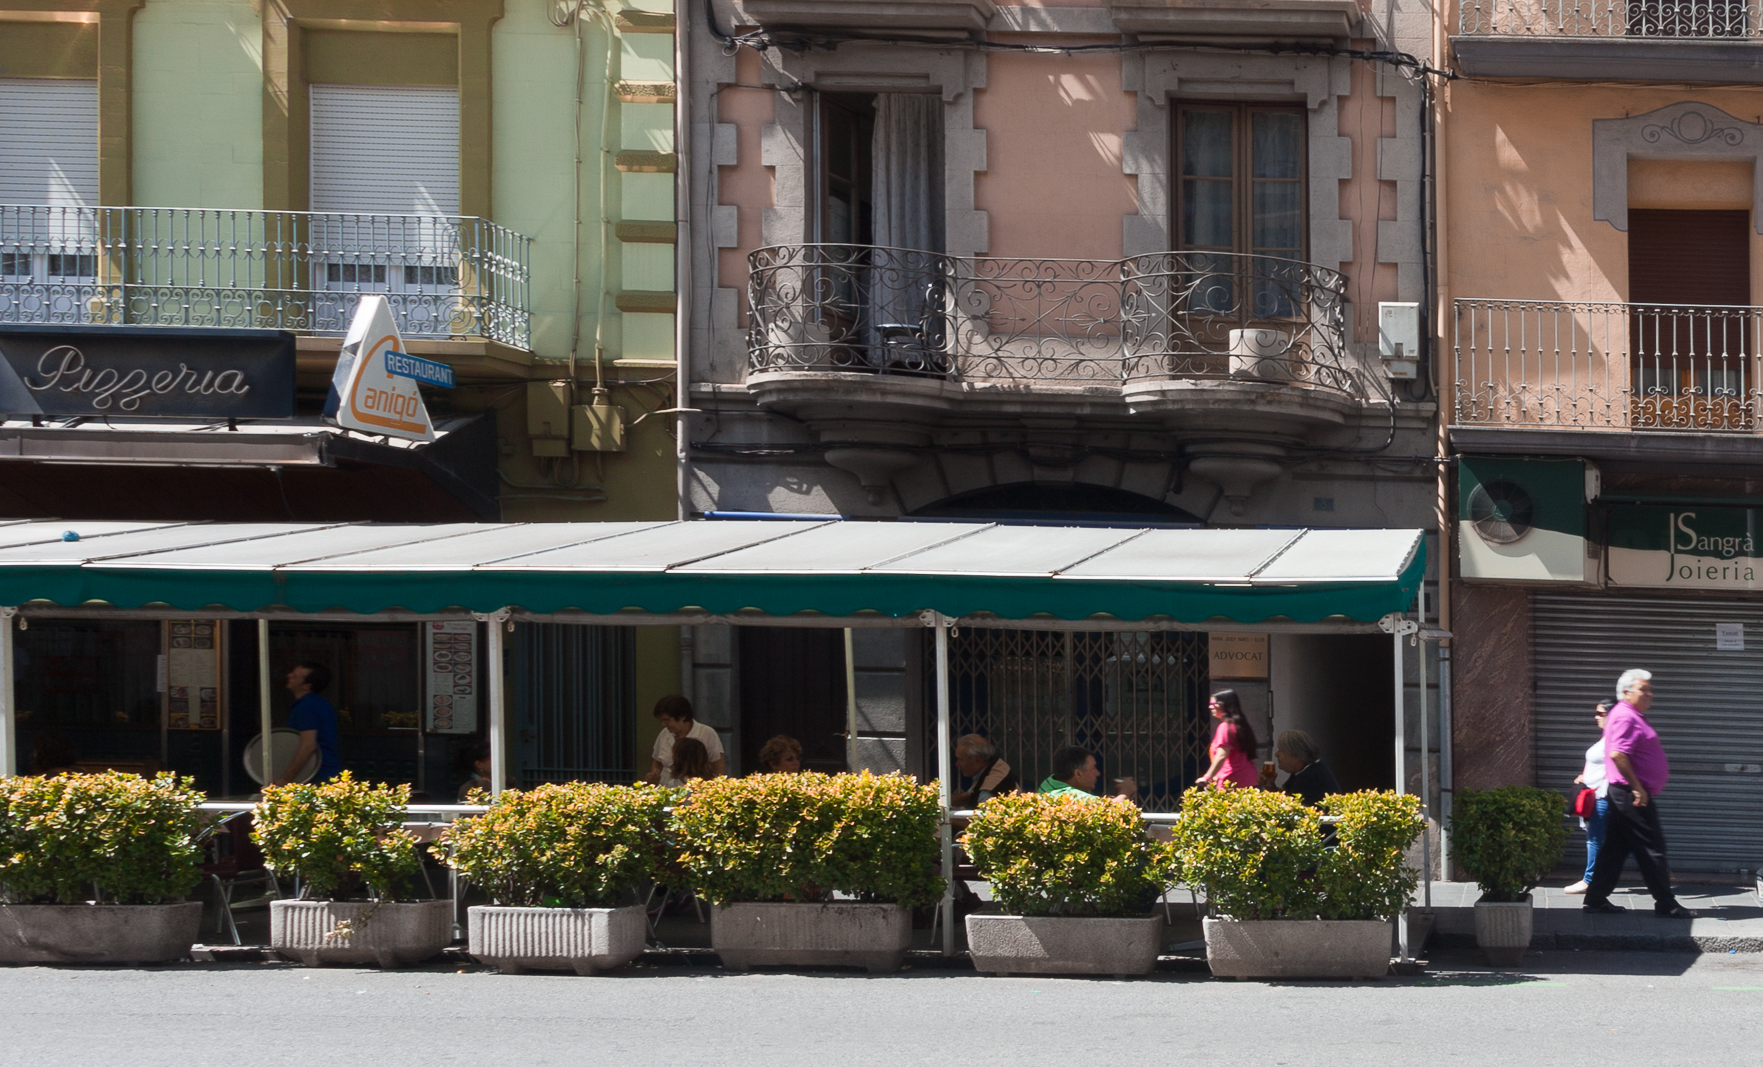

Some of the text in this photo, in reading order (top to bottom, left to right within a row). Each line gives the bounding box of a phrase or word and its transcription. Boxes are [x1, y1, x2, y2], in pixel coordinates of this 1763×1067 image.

[23, 345, 250, 411] Pizzeria
[387, 354, 453, 385] RESTAURANT
[1213, 651, 1263, 661] ADVOCAT
